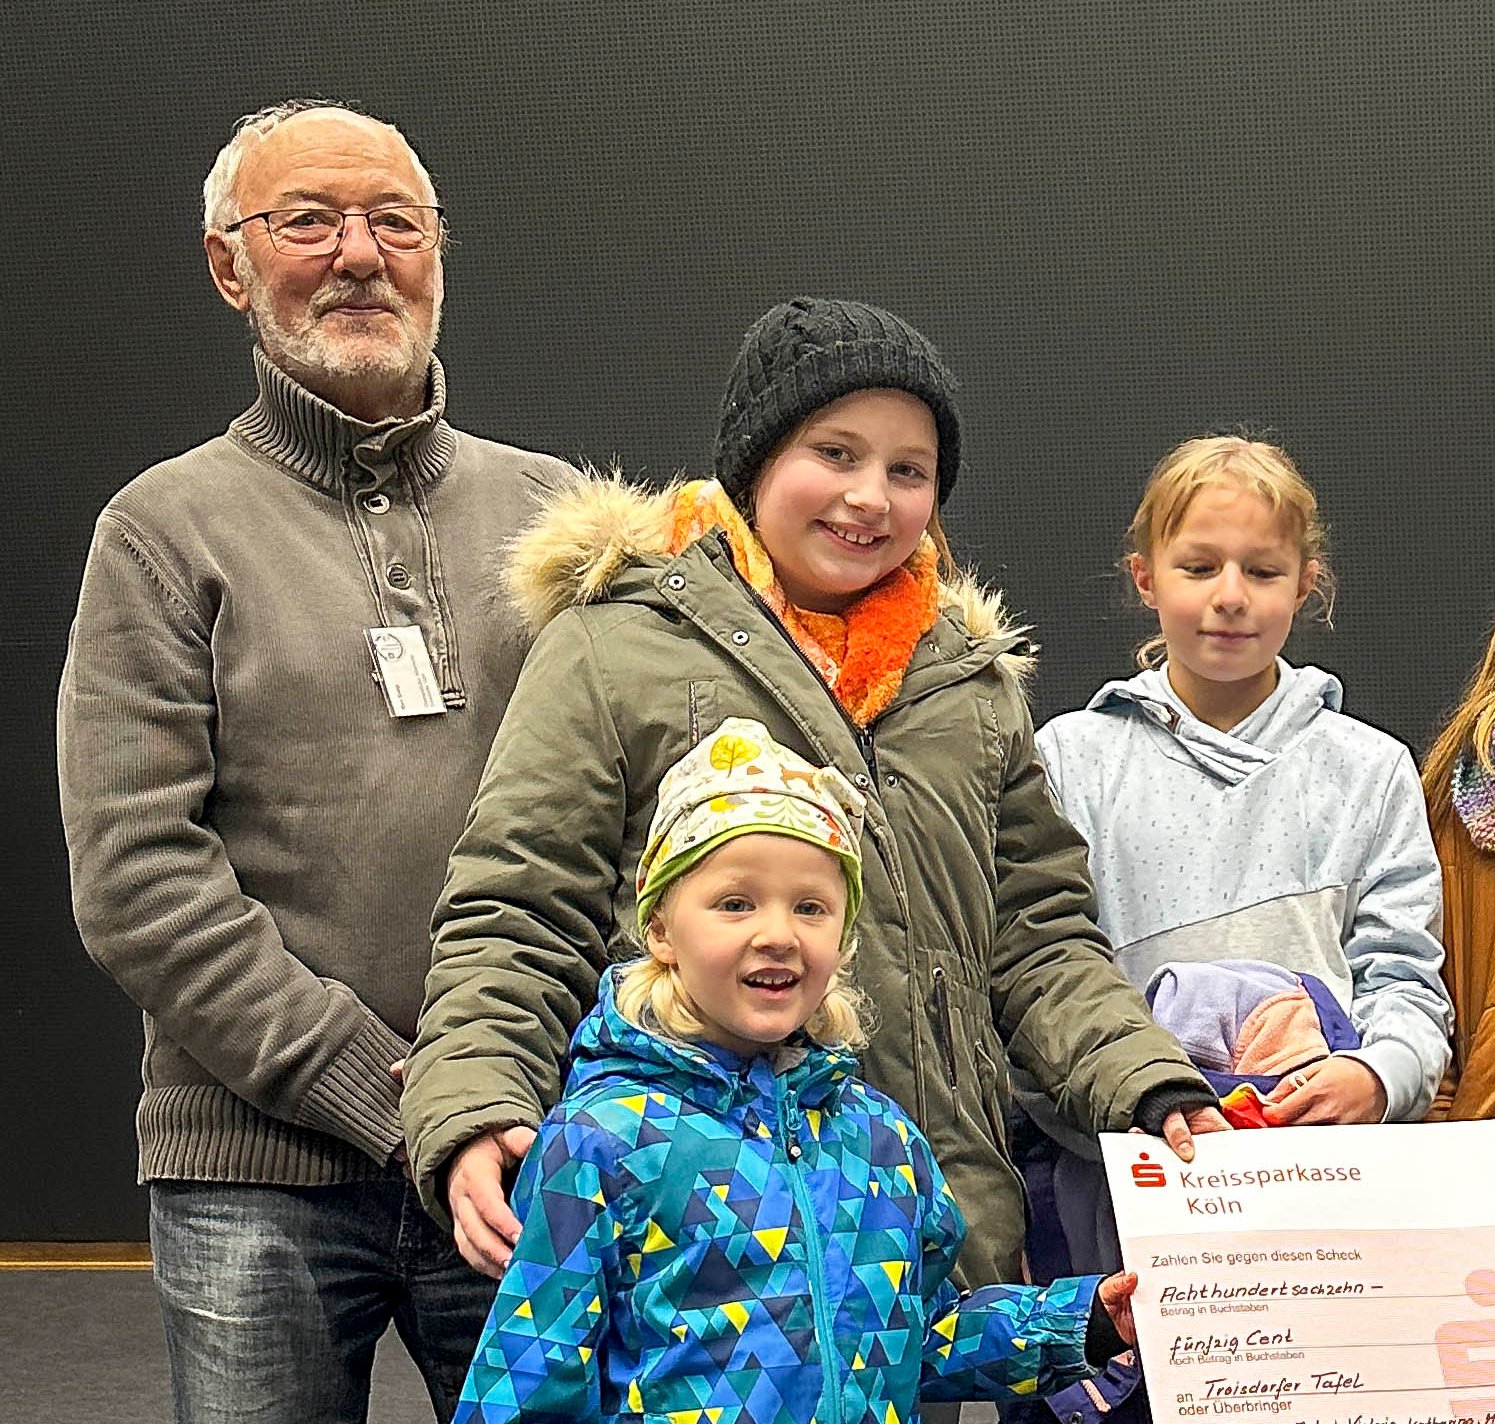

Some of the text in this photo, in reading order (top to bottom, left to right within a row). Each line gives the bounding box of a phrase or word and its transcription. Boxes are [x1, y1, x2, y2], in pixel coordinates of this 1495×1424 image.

[1180, 1163, 1362, 1189] Kreissparkasse
[1187, 1197, 1243, 1216] Köln
[1151, 1248, 1362, 1268] Zahlen Sie gegen diesen Scheck
[1161, 1302, 1269, 1317] Betrag in Buchstaben
[1246, 1329, 1294, 1346] Cent
[1170, 1351, 1305, 1366] noch Betrag in Buchstaben
[1205, 1371, 1365, 1400] Troisdorfer Tafel
[1176, 1392, 1194, 1403] an
[1178, 1400, 1292, 1417] oder Überbringer
